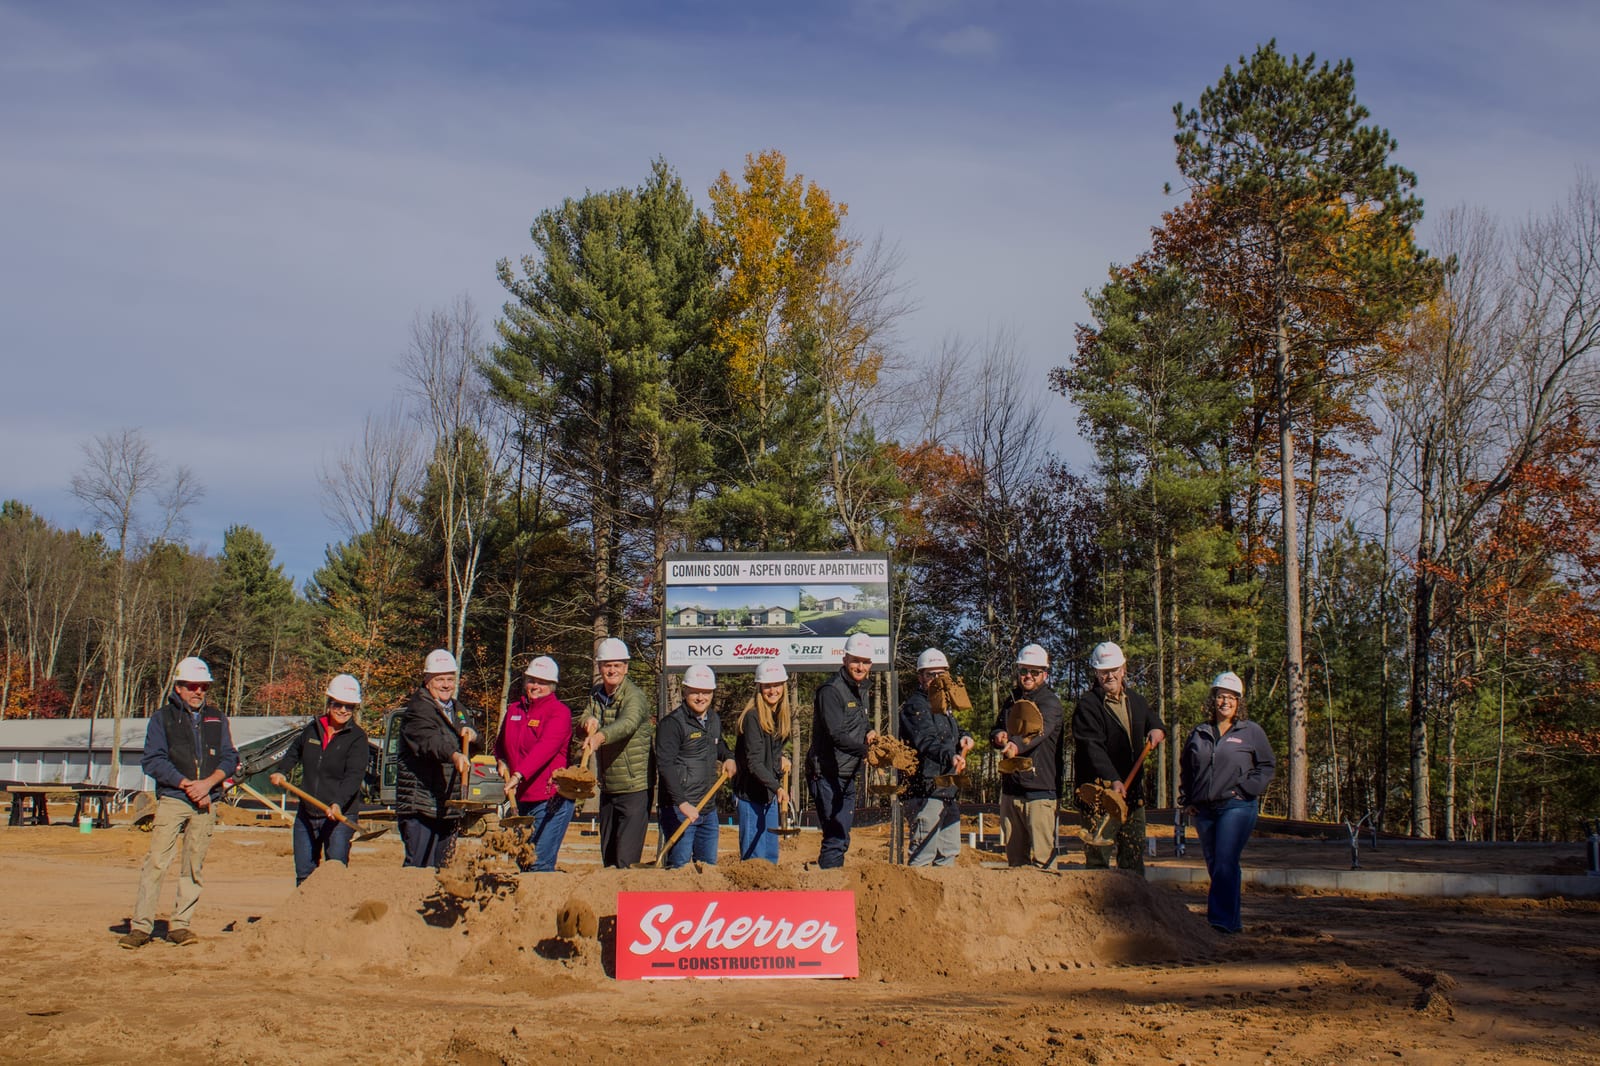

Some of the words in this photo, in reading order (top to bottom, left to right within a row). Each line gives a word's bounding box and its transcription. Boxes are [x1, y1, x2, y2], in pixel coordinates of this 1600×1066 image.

[672, 564, 711, 577] COMING
[713, 564, 740, 577] SOON
[749, 564, 782, 576] ASPEN
[784, 563, 816, 576] GROVE
[819, 563, 885, 576] APARTMENTS
[688, 644, 724, 657] RMG
[801, 645, 824, 654] REI
[629, 901, 844, 954] Scherrer
[678, 956, 796, 970] CONSTRUCTION
